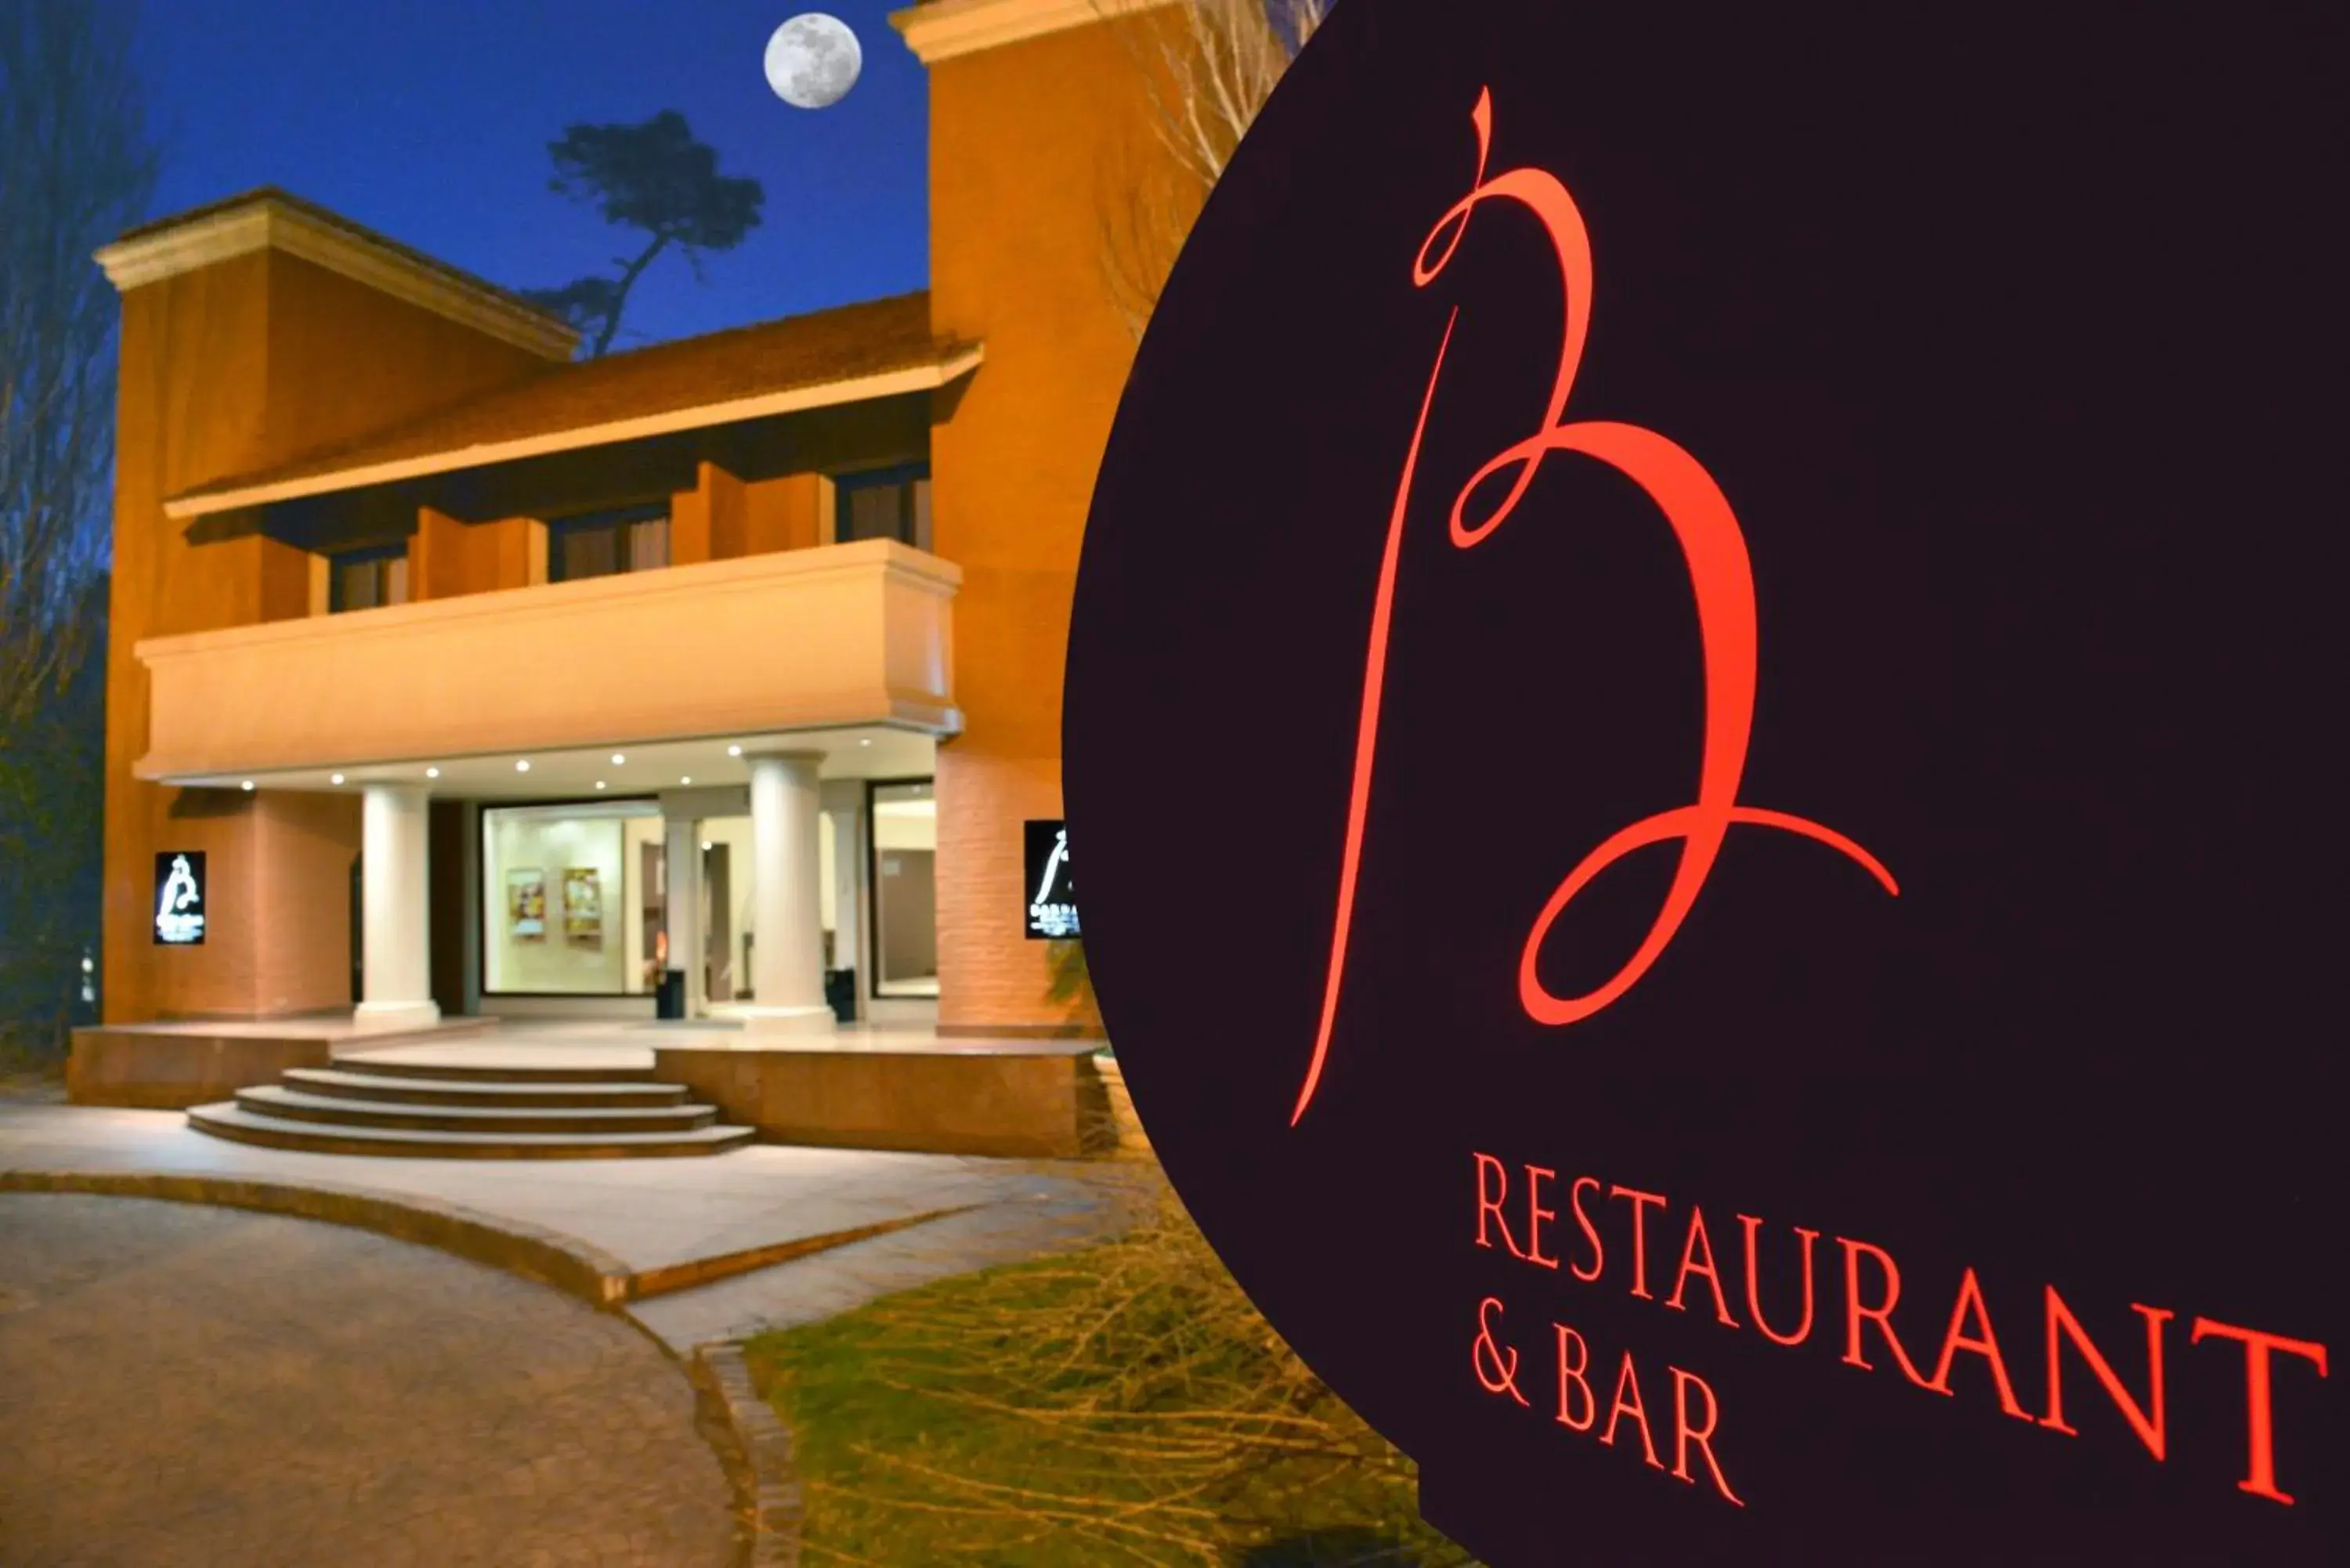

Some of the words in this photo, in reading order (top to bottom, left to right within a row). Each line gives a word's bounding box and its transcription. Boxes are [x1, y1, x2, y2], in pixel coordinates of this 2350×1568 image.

[1473, 1153, 2328, 1505] RESTAURANT
[1473, 1297, 1529, 1407] &
[1554, 1324, 1744, 1507] BAR
